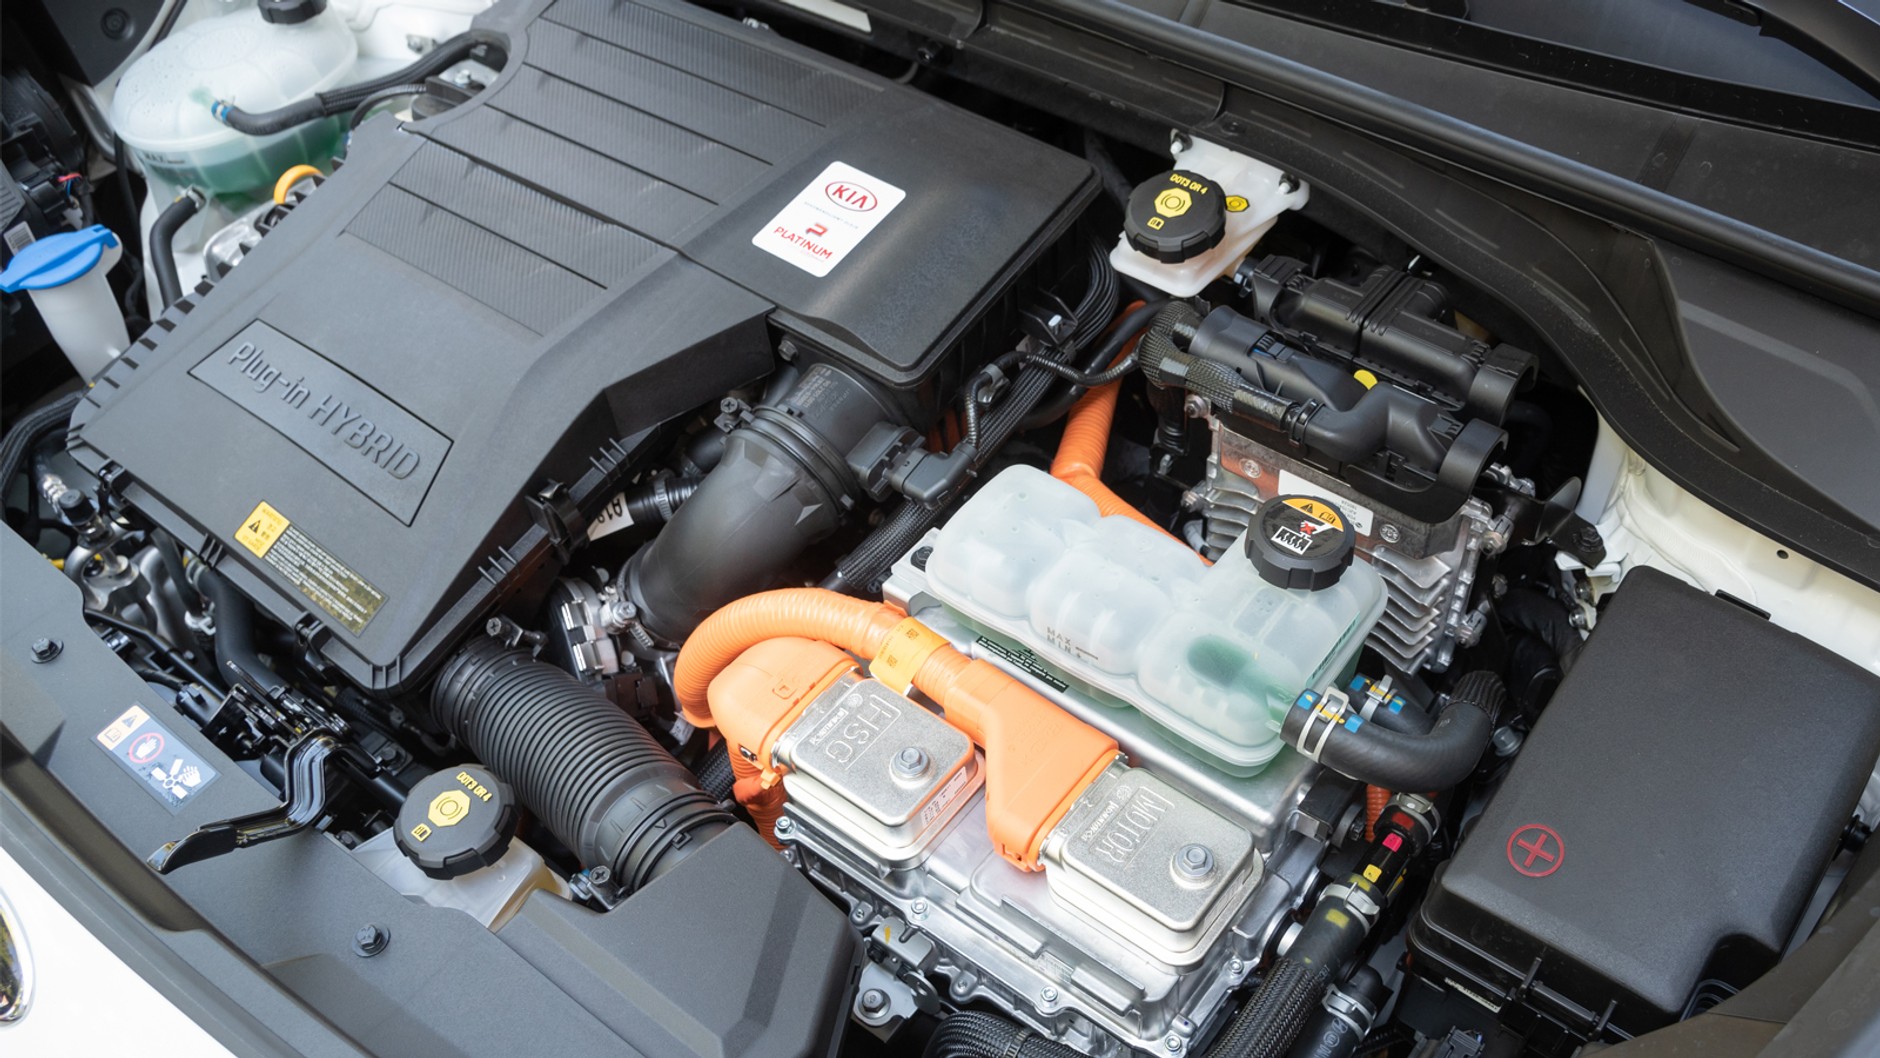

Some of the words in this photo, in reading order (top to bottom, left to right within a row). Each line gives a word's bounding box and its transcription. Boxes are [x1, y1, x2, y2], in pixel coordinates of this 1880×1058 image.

[832, 184, 868, 209] KIA
[1170, 173, 1191, 187] DOT3
[1189, 181, 1202, 192] OR
[1200, 187, 1208, 195] 4
[773, 226, 833, 259] PLATINUM
[227, 340, 311, 410] Plug-in
[307, 394, 421, 481] HYBRID
[1047, 626, 1071, 646] MAX
[1047, 634, 1071, 654] MIN
[825, 701, 892, 763] HSG
[456, 771, 478, 790] DOT3
[473, 785, 488, 798] OR
[482, 792, 492, 802] 4
[1095, 793, 1168, 864] MOTOR
